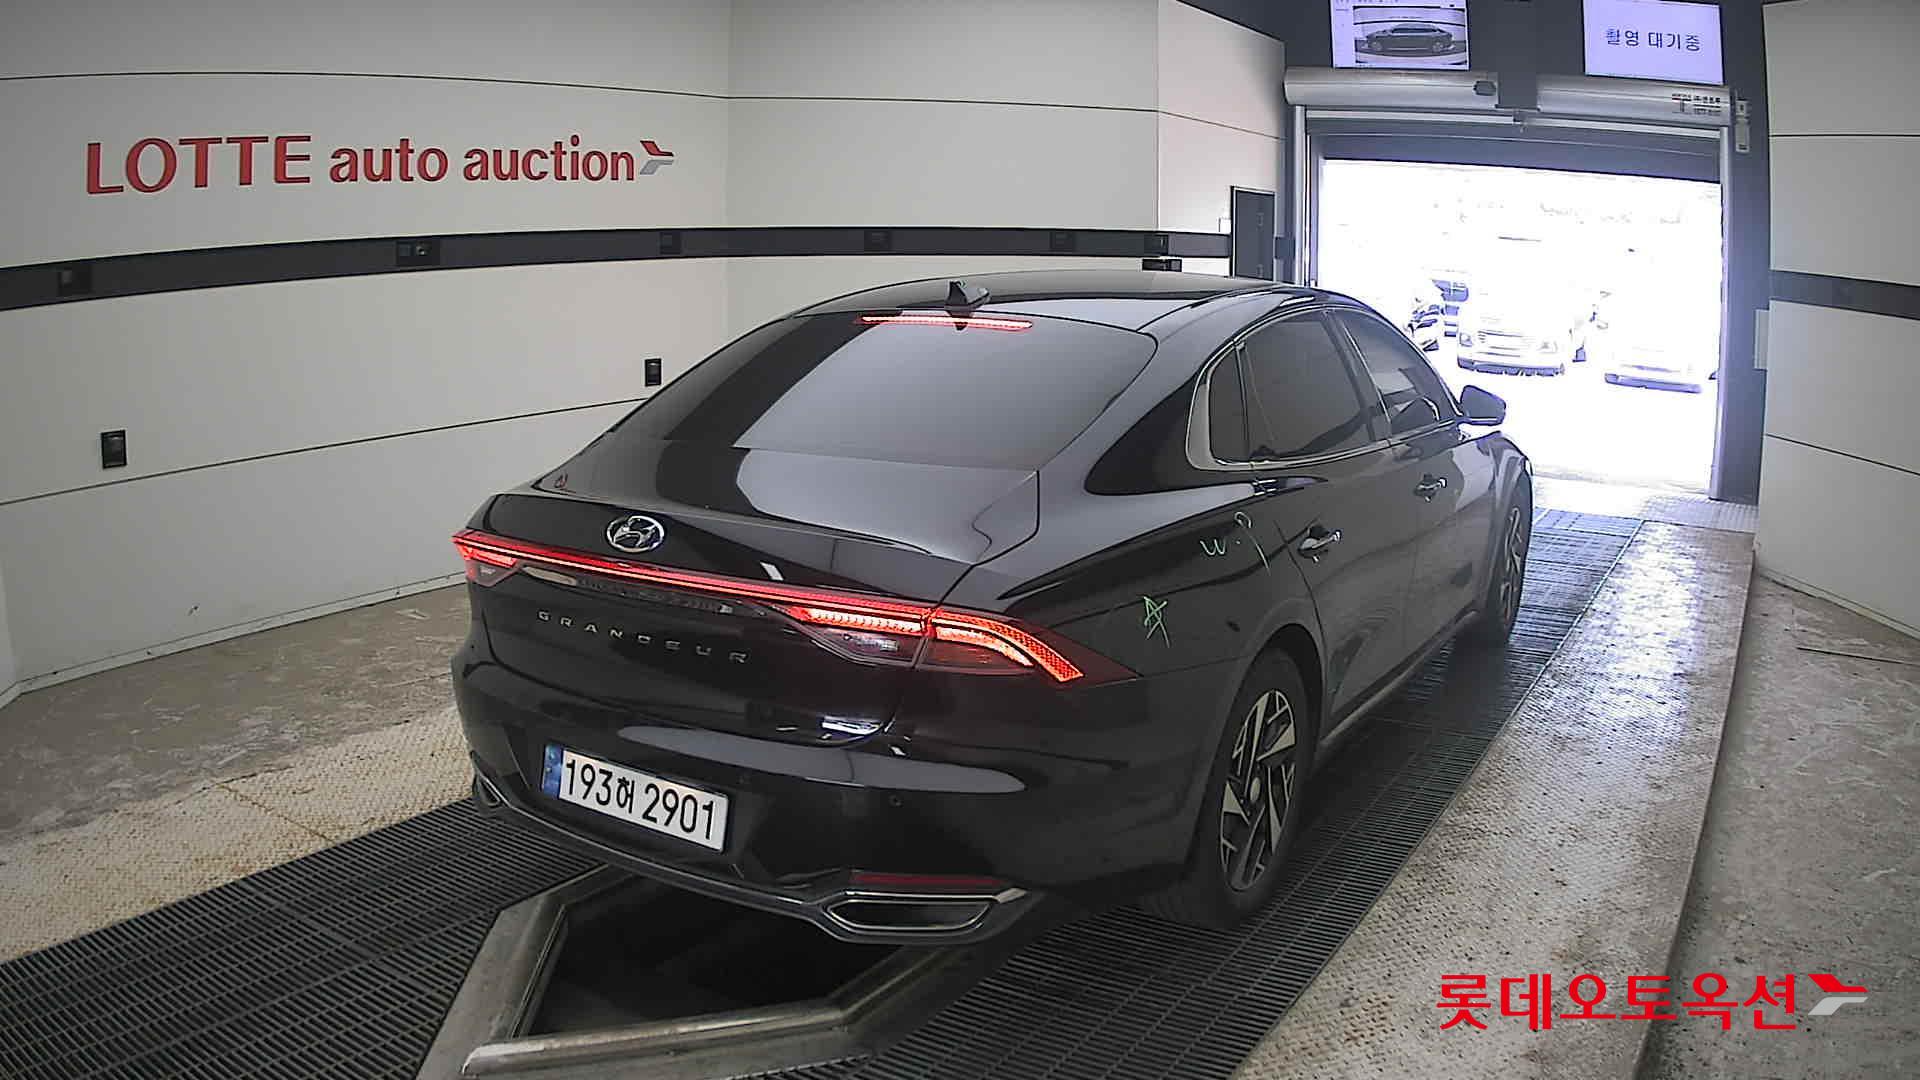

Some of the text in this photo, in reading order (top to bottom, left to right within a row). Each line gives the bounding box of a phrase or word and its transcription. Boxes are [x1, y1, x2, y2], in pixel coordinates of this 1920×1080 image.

[1648, 31, 1700, 52] 대기중
[86, 134, 635, 195] LOTTE auto auction
[537, 610, 748, 664] GRANDEUR
[566, 759, 715, 840] 193허 2901
